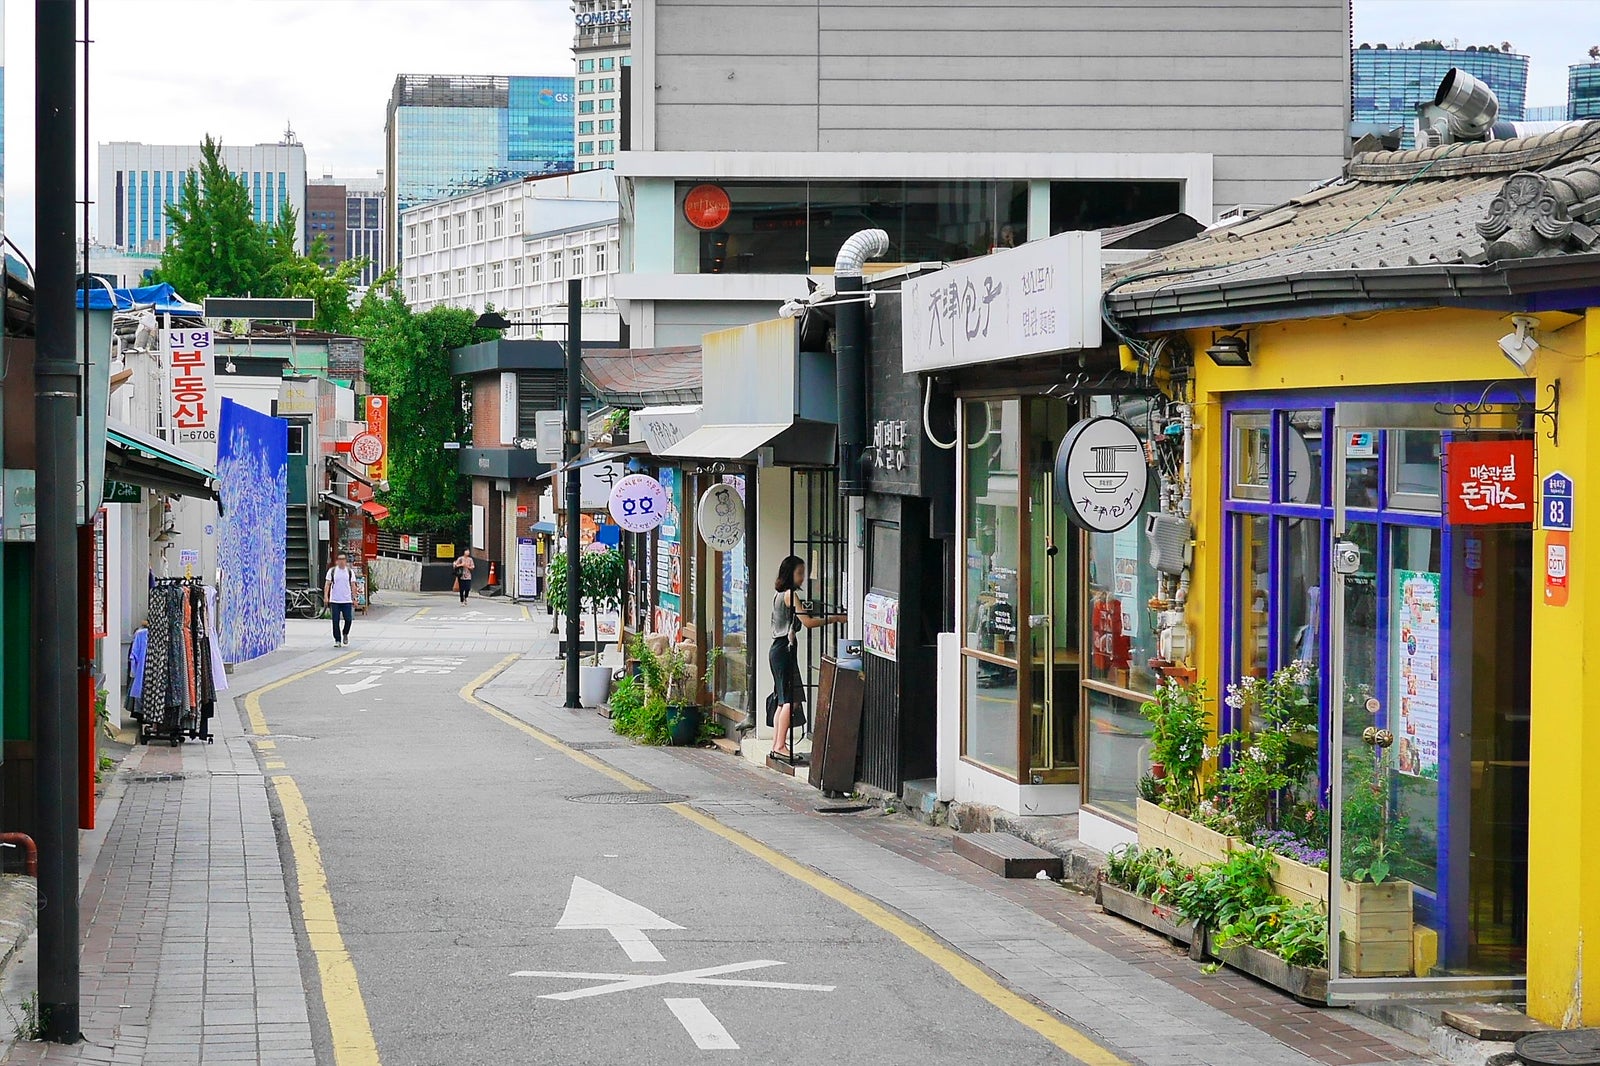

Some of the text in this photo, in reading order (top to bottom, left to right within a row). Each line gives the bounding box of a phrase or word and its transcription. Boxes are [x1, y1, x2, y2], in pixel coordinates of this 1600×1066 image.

[575, 9, 631, 27] SOMERSE
[171, 350, 208, 428] 부동산
[622, 496, 654, 516] 호호
[1459, 482, 1526, 511] 돈까스
[1549, 500, 1564, 523] 83
